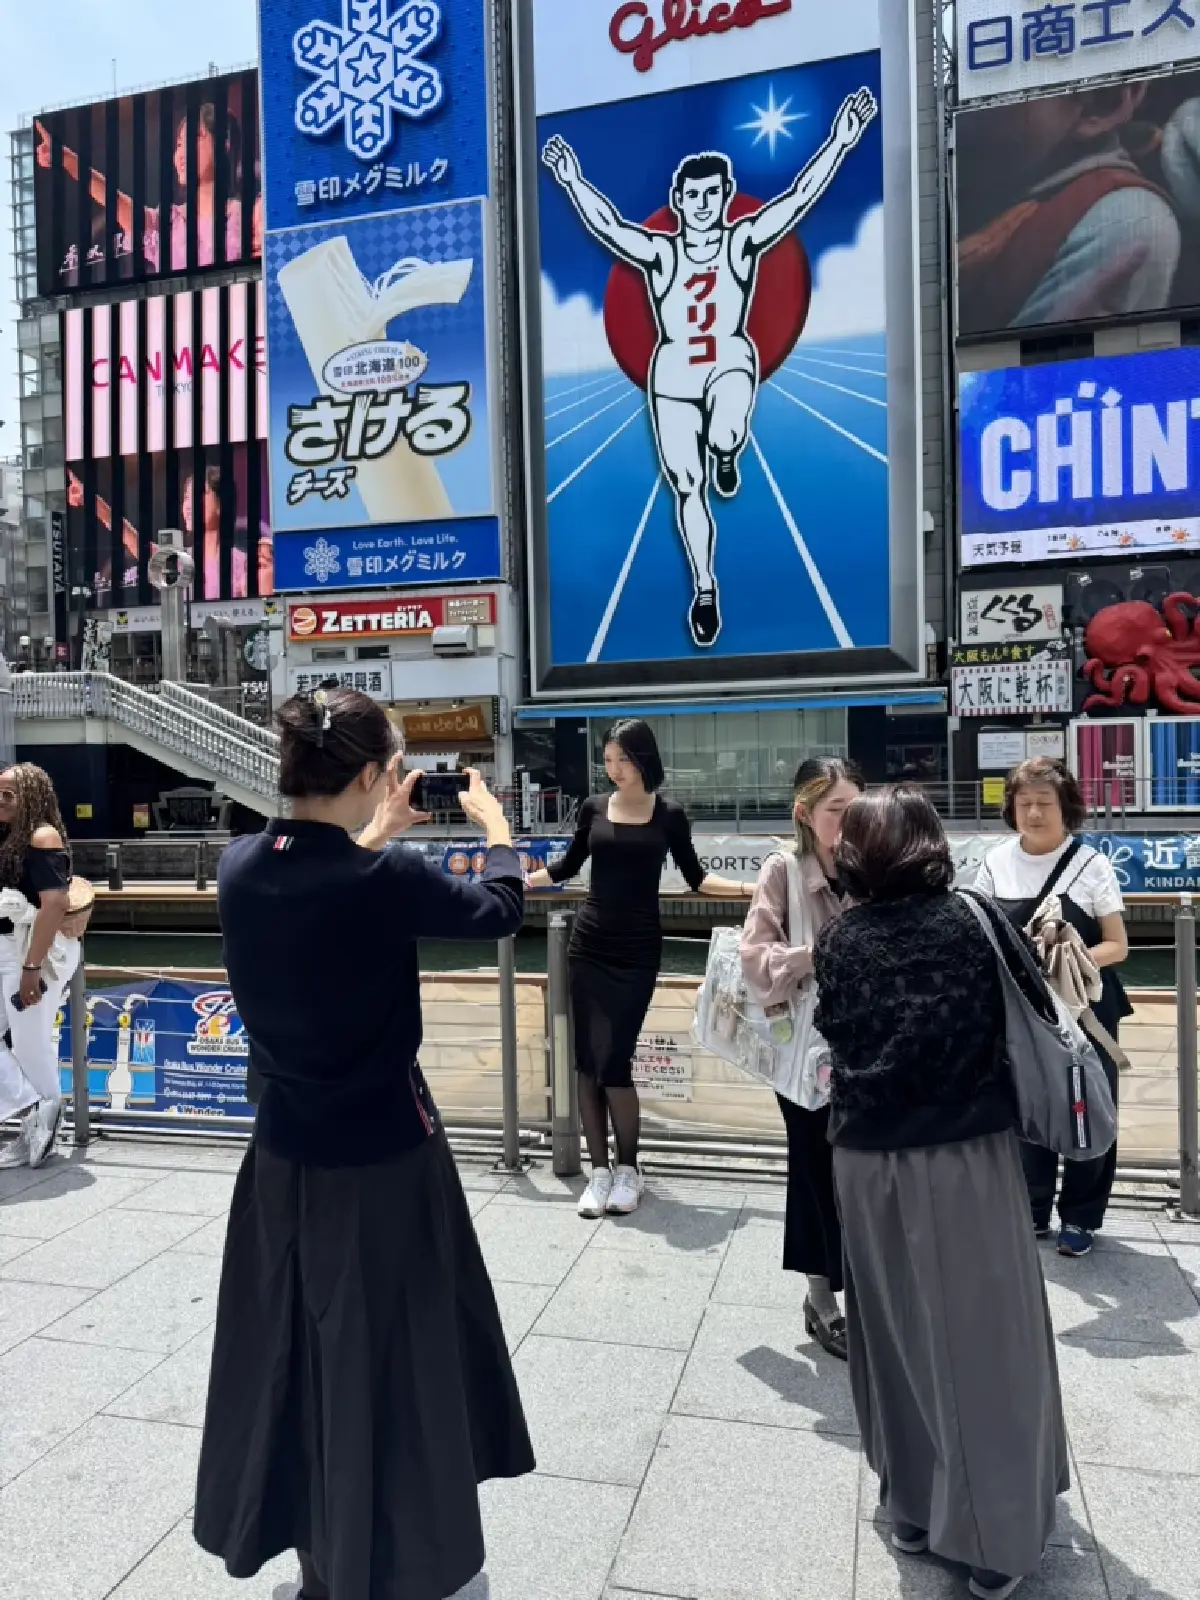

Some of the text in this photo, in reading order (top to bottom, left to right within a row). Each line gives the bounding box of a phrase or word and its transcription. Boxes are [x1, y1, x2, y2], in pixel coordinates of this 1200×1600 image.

[295, 158, 449, 206] 雪印メグミルク
[683, 265, 719, 365] グリコ
[285, 381, 471, 466] さける
[287, 466, 357, 505] チーズ
[53, 519, 65, 593] TSUTAYA
[352, 540, 376, 550] Love
[411, 536, 434, 546] Love
[347, 549, 467, 577] 雪印メグミルク
[980, 594, 1043, 632] くくる
[958, 672, 1053, 707] 大阪に乾杯
